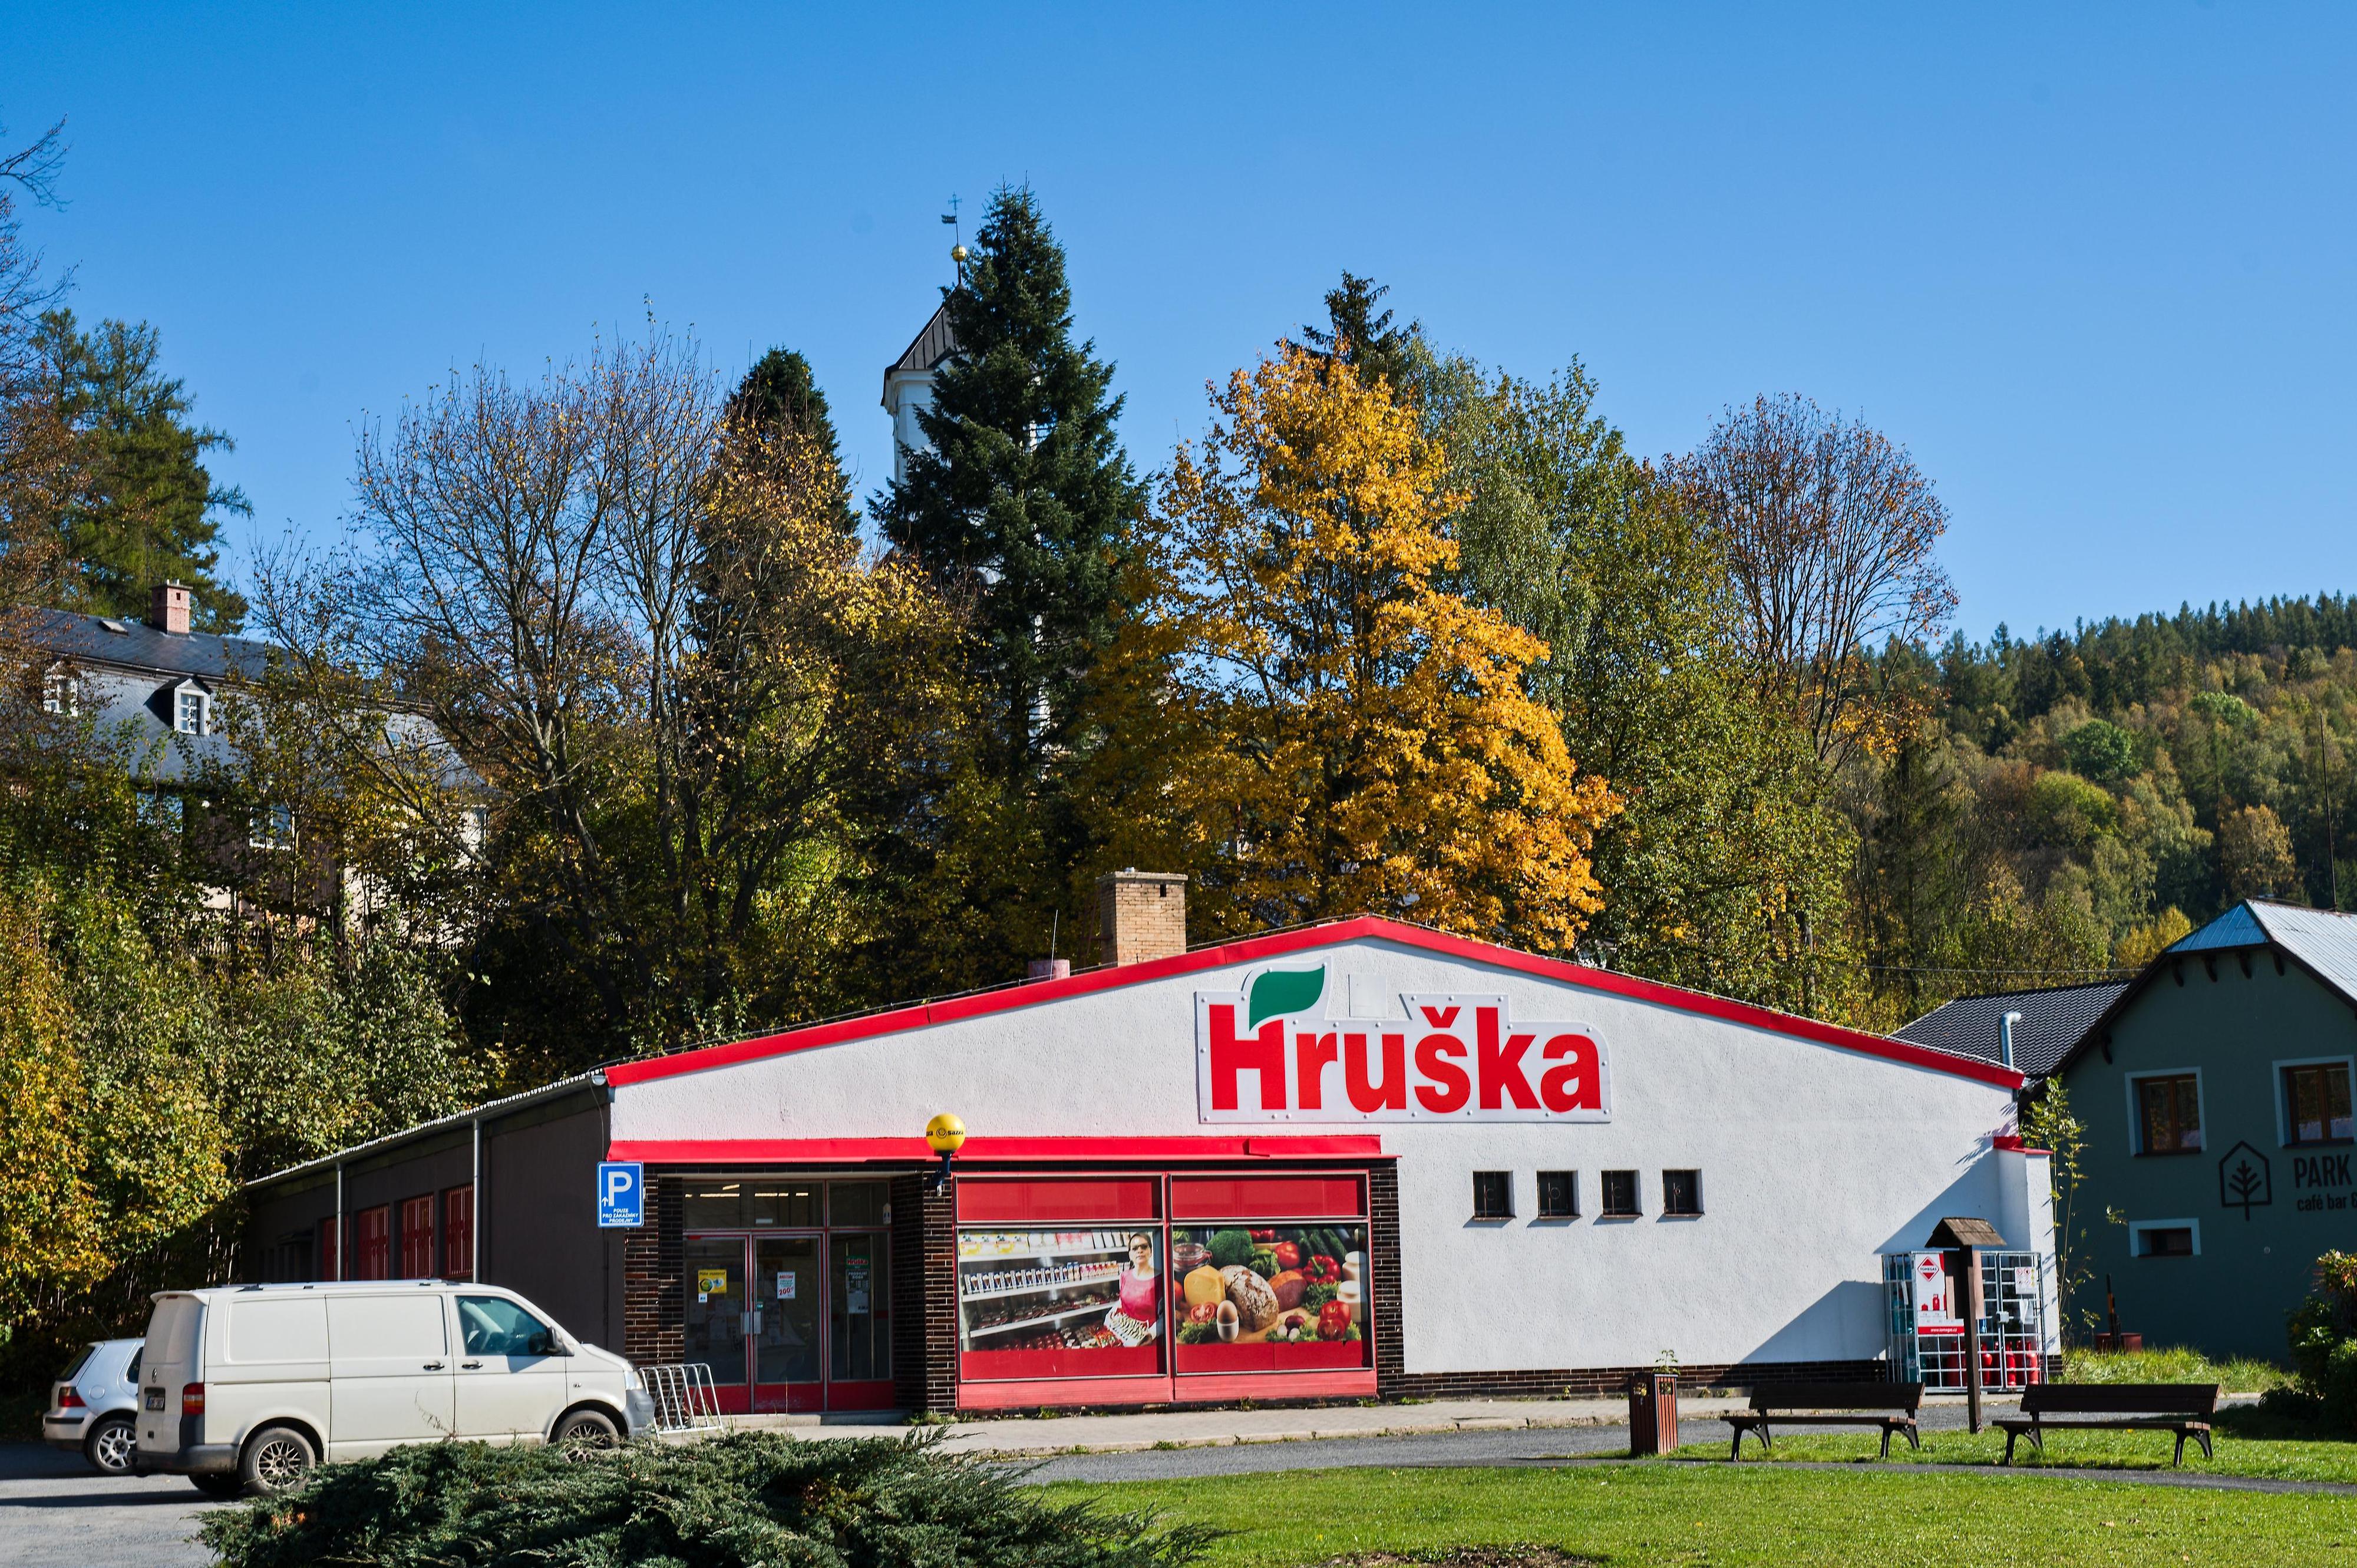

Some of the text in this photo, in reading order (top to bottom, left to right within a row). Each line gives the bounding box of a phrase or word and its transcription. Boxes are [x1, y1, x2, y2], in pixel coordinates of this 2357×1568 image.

[1209, 1004, 1602, 1113] Hruška
[2293, 1154, 2352, 1188] PARK
[608, 1171, 632, 1206] P
[2297, 1194, 2323, 1212] café
[2327, 1193, 2347, 1210] bar
